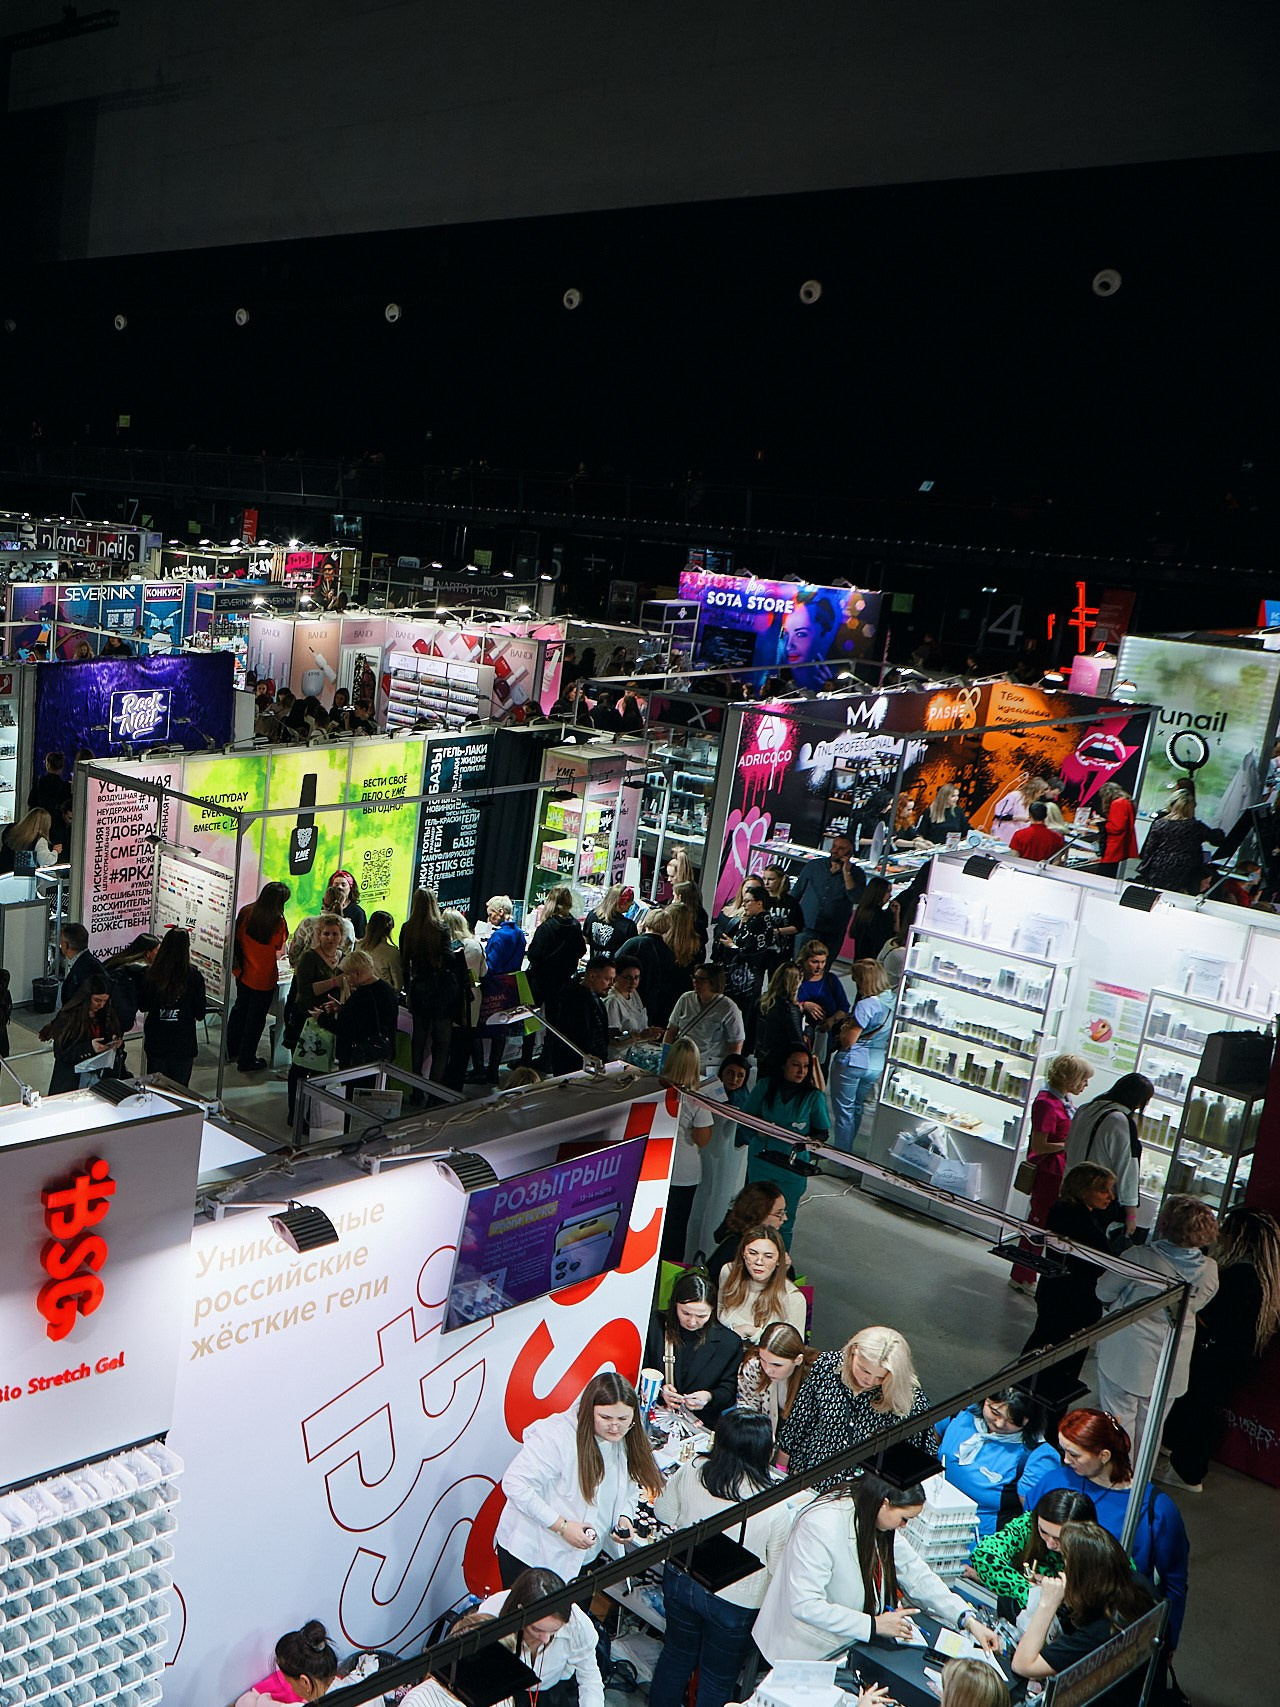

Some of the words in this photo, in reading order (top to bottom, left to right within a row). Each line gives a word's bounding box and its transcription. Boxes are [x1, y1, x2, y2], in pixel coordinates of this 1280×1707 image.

[98, 534, 135, 561] nails
[146, 588, 182, 597] КОНКУРС
[706, 591, 742, 608] SOTA
[747, 596, 794, 614] STORE
[988, 604, 1024, 646] 4
[262, 628, 280, 638] BANDI
[308, 631, 328, 639] BANDI
[354, 630, 374, 638] BANDI
[395, 630, 415, 640] BANDI
[510, 649, 533, 660] BANDI
[122, 692, 168, 715] Rock
[1160, 708, 1228, 732] unail
[442, 744, 488, 758] ГЕЛЬ-ЛАКИ
[834, 738, 892, 754] PROFESSIONAL
[460, 755, 486, 765] ЖИДКИЕ
[738, 750, 792, 767] ADRICOCO
[428, 748, 443, 794] БАЗЫ
[364, 777, 386, 788] ВЕСТИ
[388, 772, 408, 786] СВОЁ
[98, 792, 138, 802] ВОЗДУШНАЯ
[361, 790, 382, 802] ДЕЛО
[384, 790, 390, 799] С
[96, 804, 148, 816] НЕУДЕРЖИМАЯ
[426, 802, 456, 813] НОВИНКИ
[96, 814, 142, 826] #СТИЛЬНАЯ
[424, 816, 461, 826] ГЕЛЬ-КРАСКИ
[461, 813, 480, 824] ГЕЛИ
[194, 822, 222, 833] ВМЕСТЕ
[222, 822, 228, 830] С
[422, 826, 431, 854] ТОПЫ
[434, 826, 444, 853] ГЕЛИ
[452, 836, 476, 849] БАЗЫ
[93, 826, 104, 894] ИСКРЕННЯЯ
[421, 848, 476, 862] КАМУФЛИРУЮЩИЕ
[436, 860, 458, 872] STIKS
[460, 857, 474, 868] GEL
[109, 863, 156, 884] #ЯРКА
[434, 871, 456, 880] ГЕЛЕВЫЕ
[456, 868, 474, 876] ТИПСЫ
[92, 888, 152, 903] СНОГСШИБАТЕЛЬ
[92, 896, 152, 913] ВОСХИТИТЕЛЬН
[91, 916, 150, 933] БОЖЕСТВЕНН
[92, 915, 122, 924] РОСКОШНАЯ
[132, 910, 150, 918] ВОЛШЕ
[493, 1154, 622, 1216] РОЗЫГРЫШ
[493, 1217, 524, 1234] iPhone
[535, 1204, 557, 1221] PRO
[196, 1202, 385, 1279] Униканые
[194, 1246, 369, 1328] российские
[190, 1300, 316, 1361] жёсткие
[326, 1275, 389, 1314] гели
[28, 1362, 91, 1395] Stretch
[95, 1351, 125, 1375] Gel
